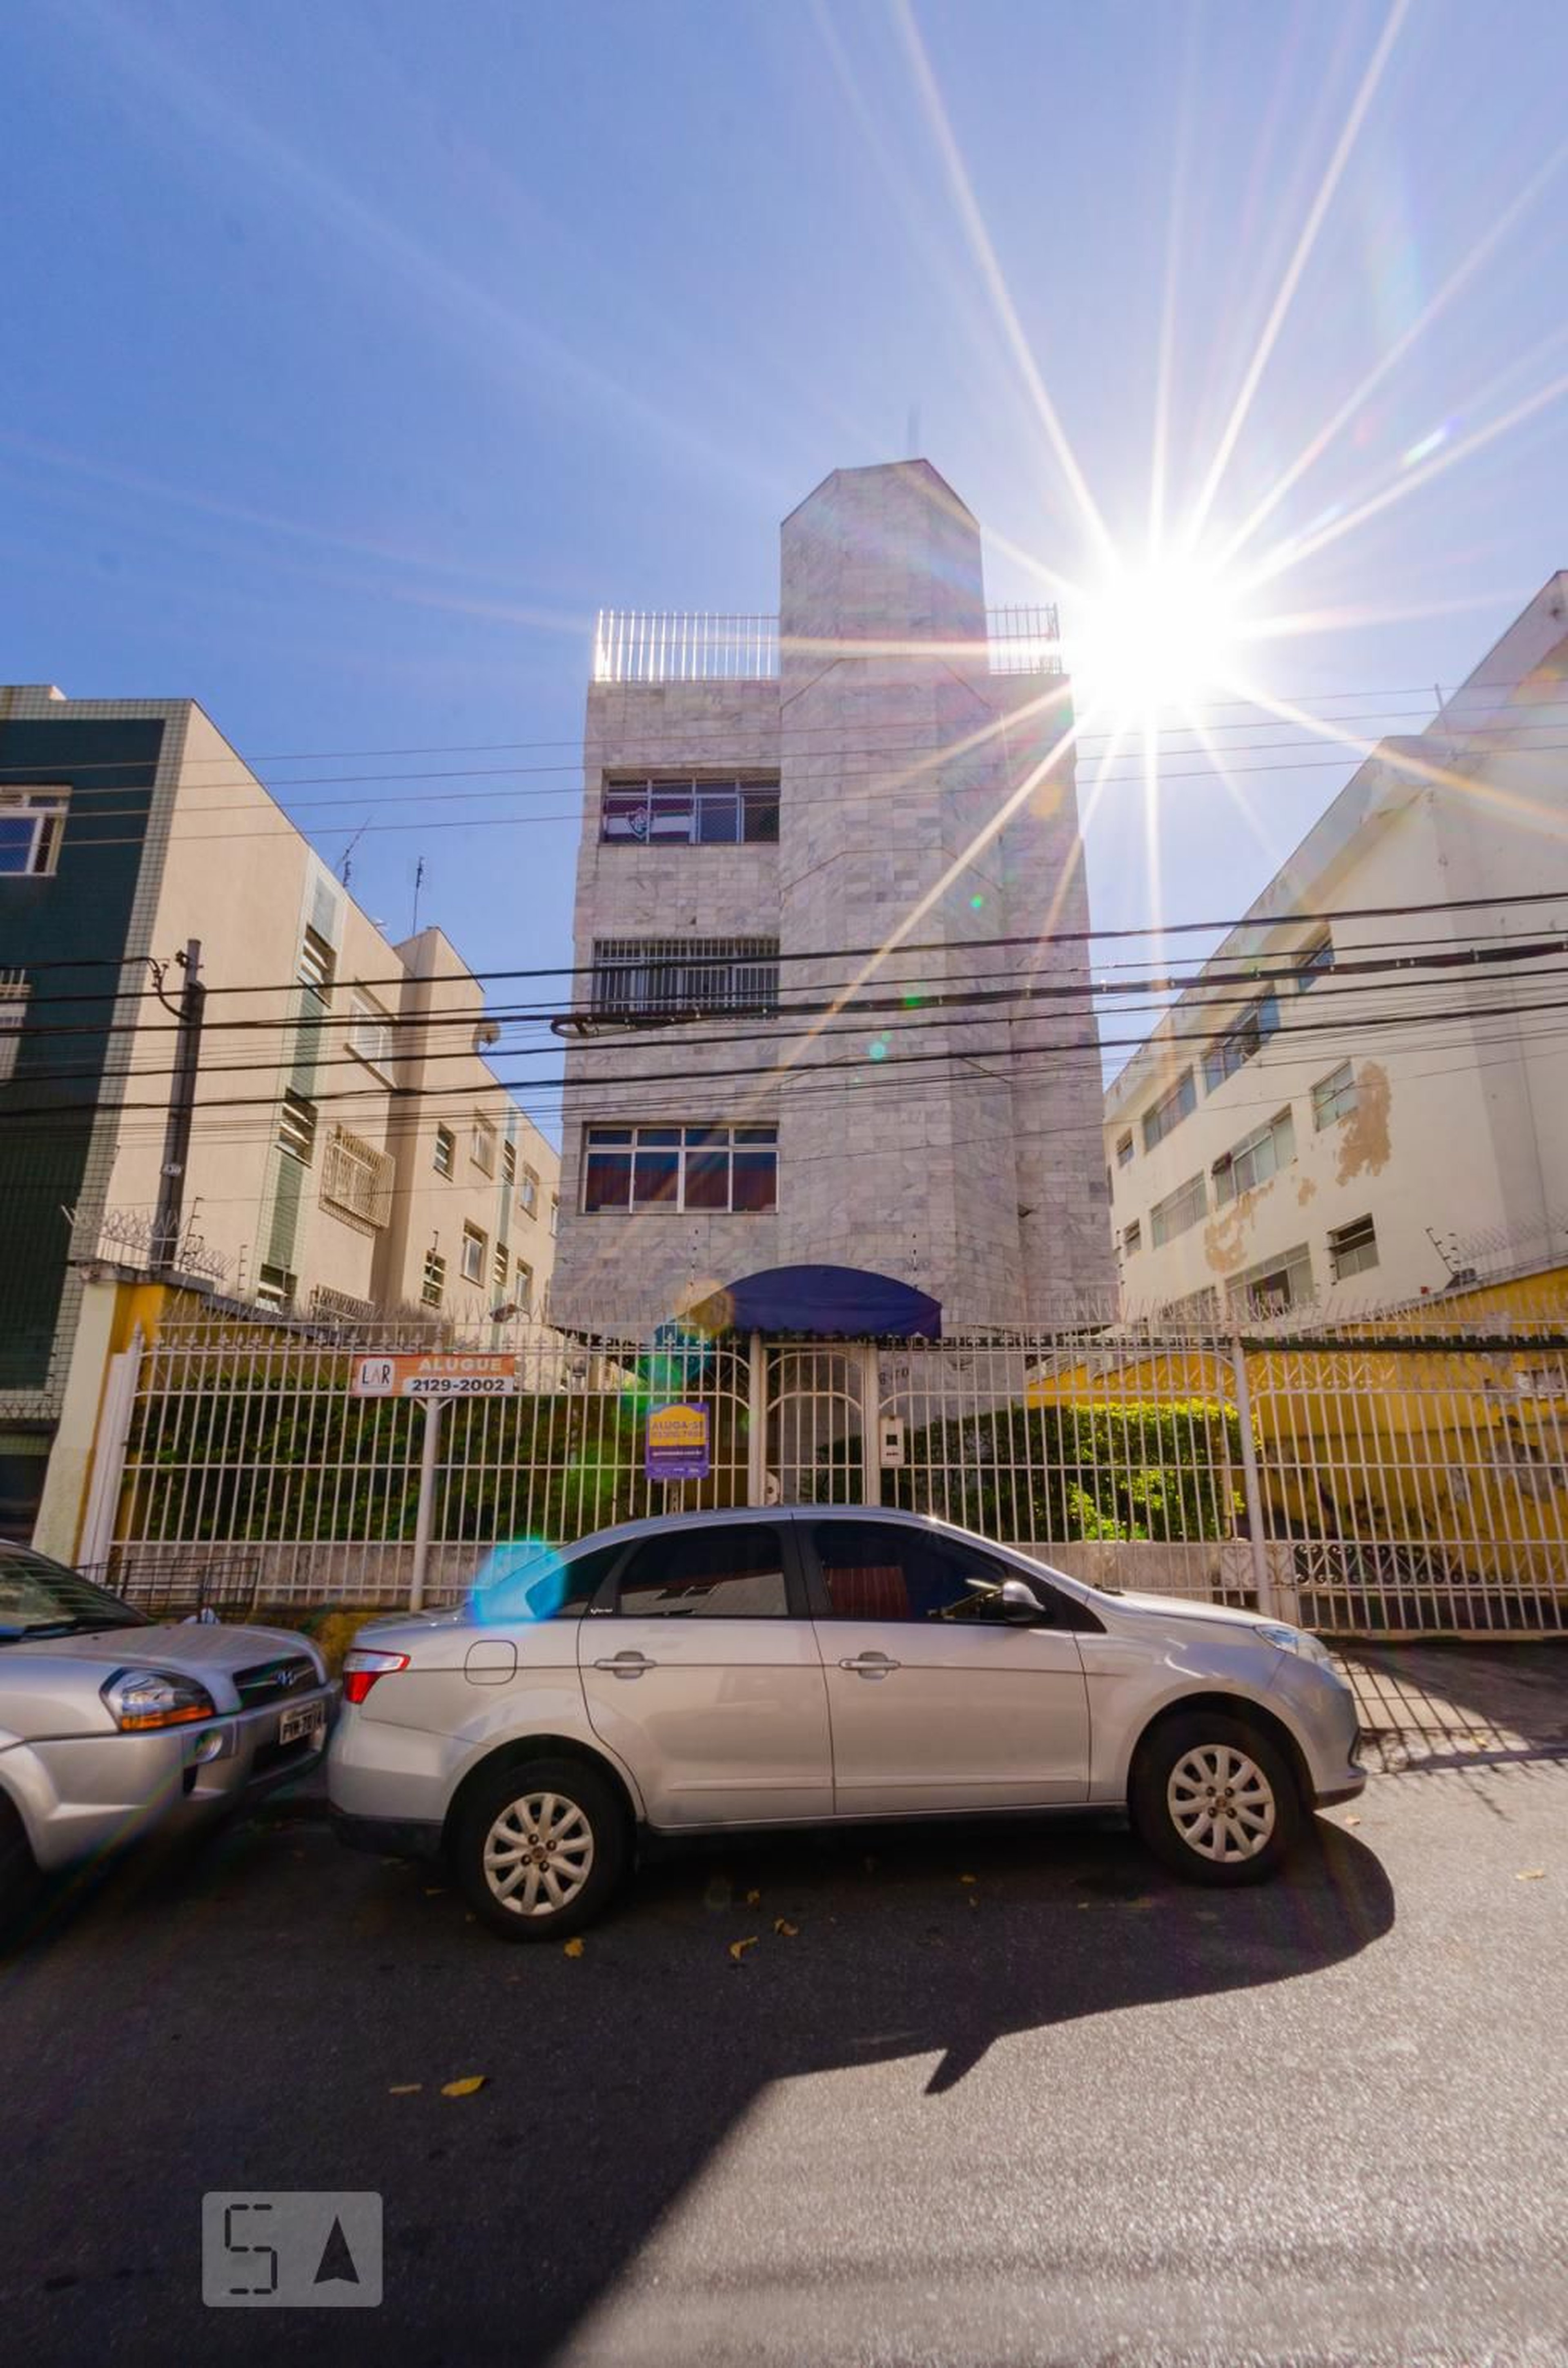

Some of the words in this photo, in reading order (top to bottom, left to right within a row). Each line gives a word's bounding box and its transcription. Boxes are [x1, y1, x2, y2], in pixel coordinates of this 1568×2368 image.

[418, 1358, 502, 1371] ALUGUE
[362, 1365, 390, 1385] LAR
[413, 1379, 505, 1392] 2129-2002
